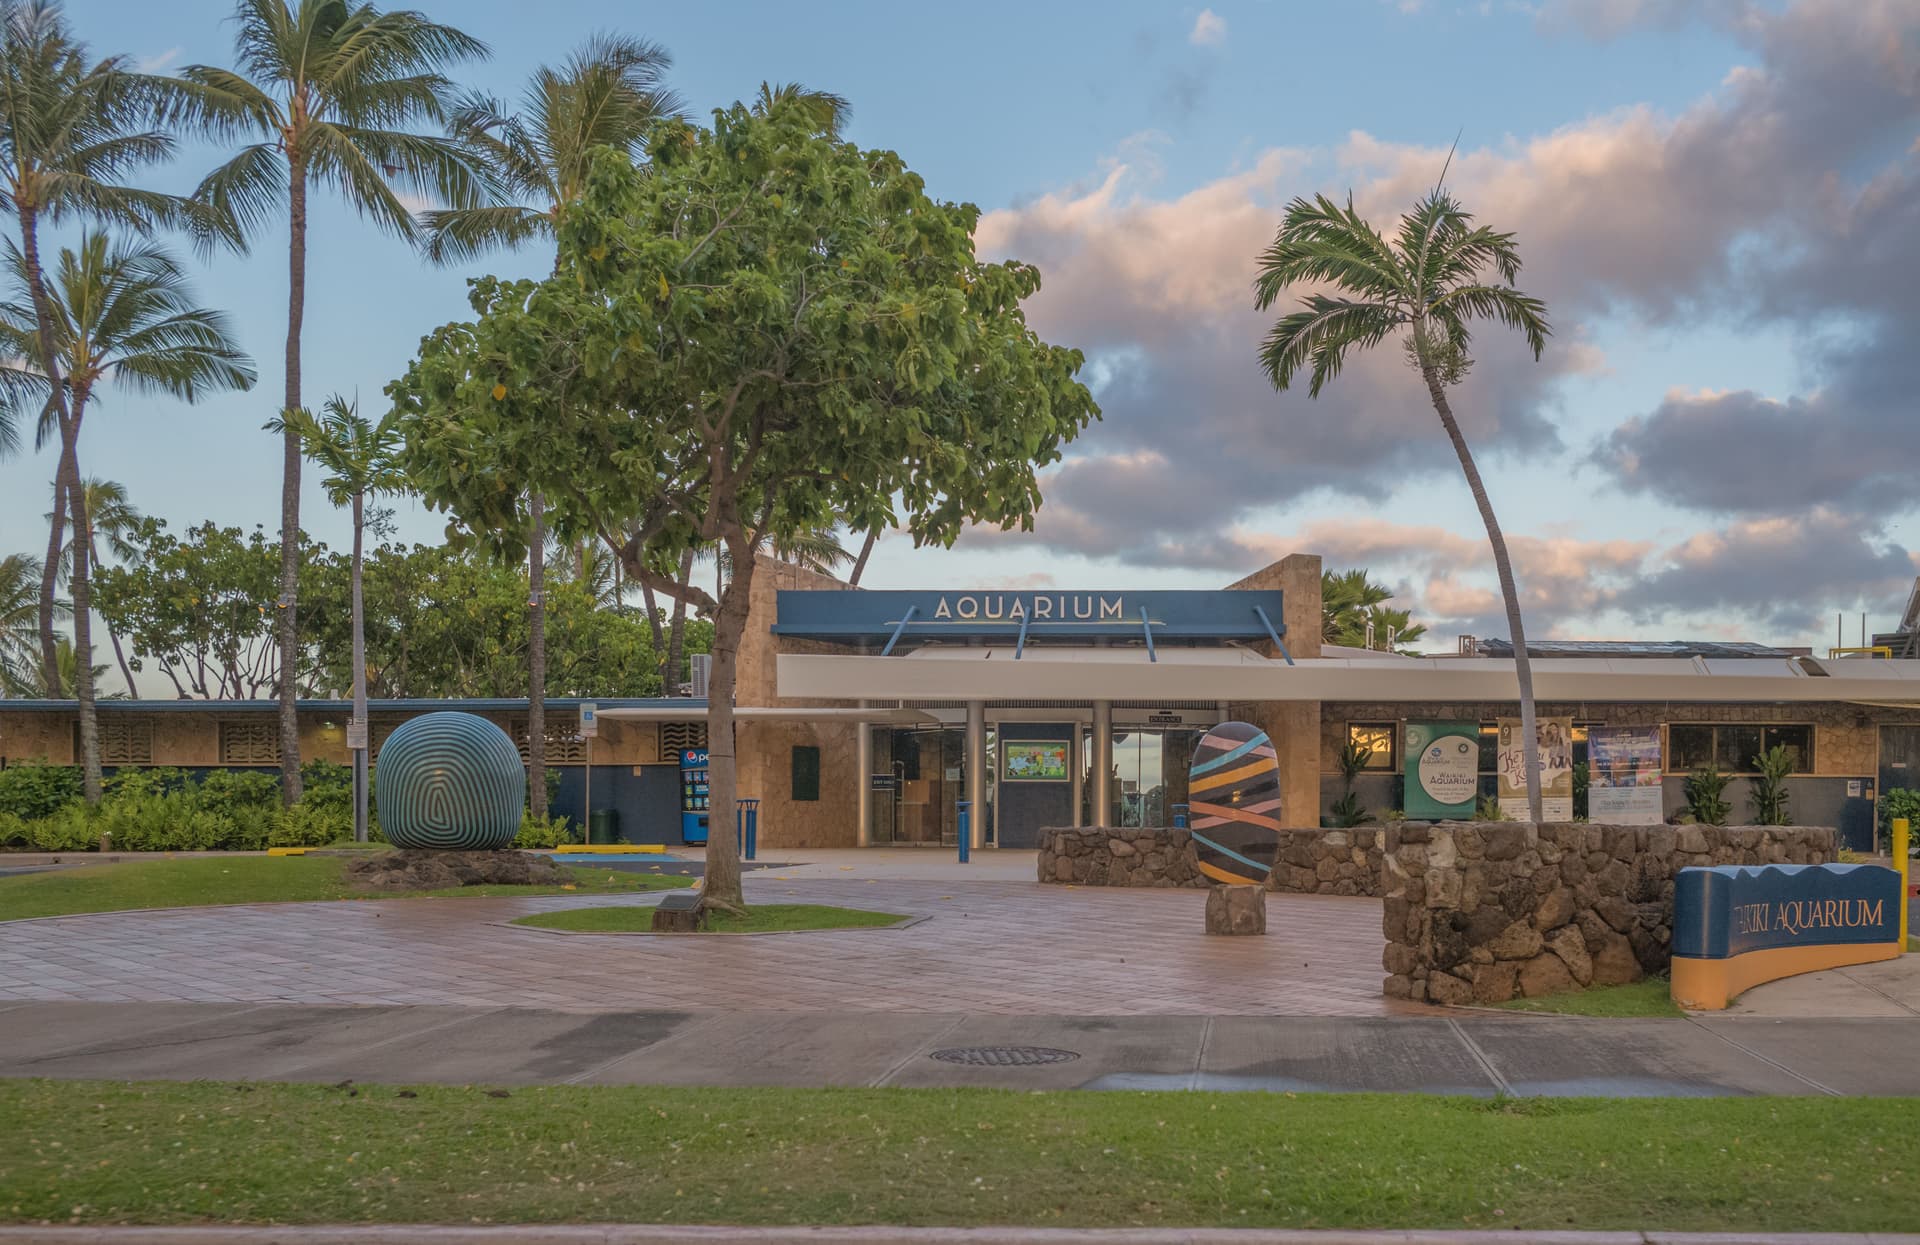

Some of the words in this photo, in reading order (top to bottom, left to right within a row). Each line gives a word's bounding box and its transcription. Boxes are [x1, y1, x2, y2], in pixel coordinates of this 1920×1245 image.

[935, 596, 1122, 618] AQUARIUM
[1430, 776, 1475, 785] AQUARIUM
[1773, 899, 1884, 935] AQUARIUM
